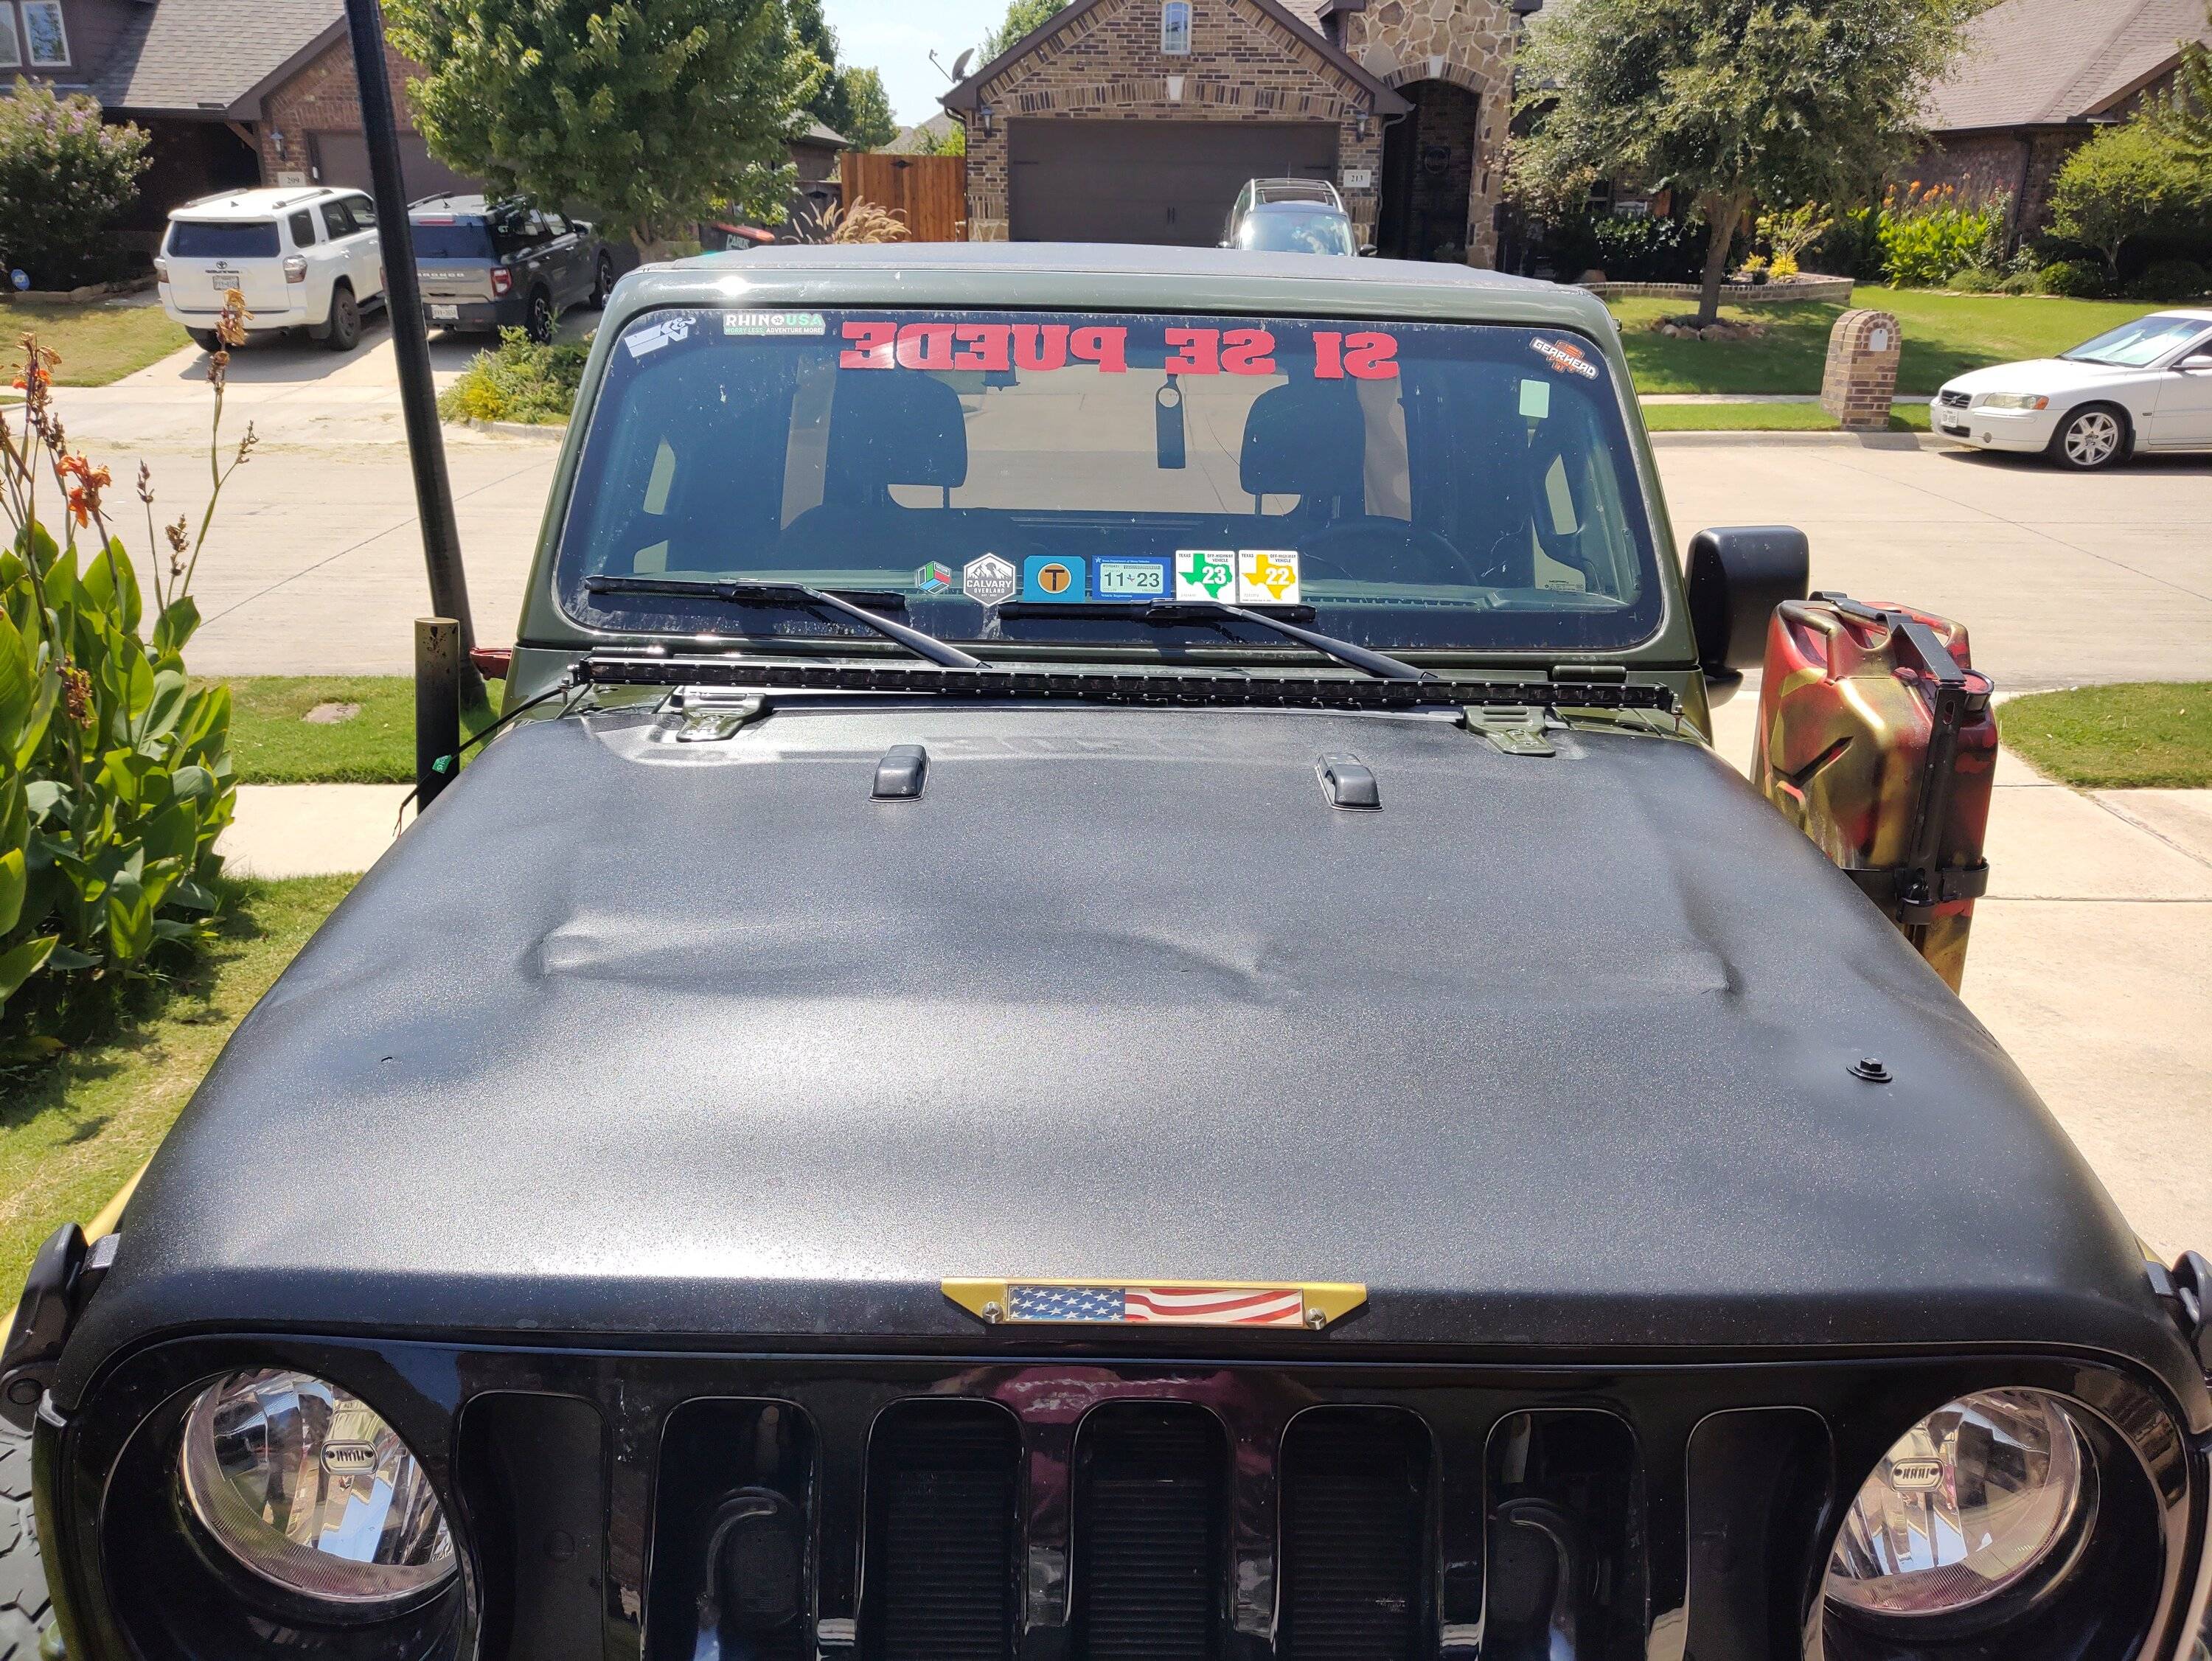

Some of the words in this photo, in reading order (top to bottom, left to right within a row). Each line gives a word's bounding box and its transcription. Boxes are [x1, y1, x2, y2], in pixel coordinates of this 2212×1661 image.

[1534, 339, 1596, 376] GEARHEAD
[967, 580, 1012, 588] CALVARY
[1045, 569, 1065, 591] T
[1105, 572, 1123, 587] 11
[1137, 572, 1160, 588] 23
[1202, 566, 1226, 584] 23
[1265, 567, 1290, 585] 22
